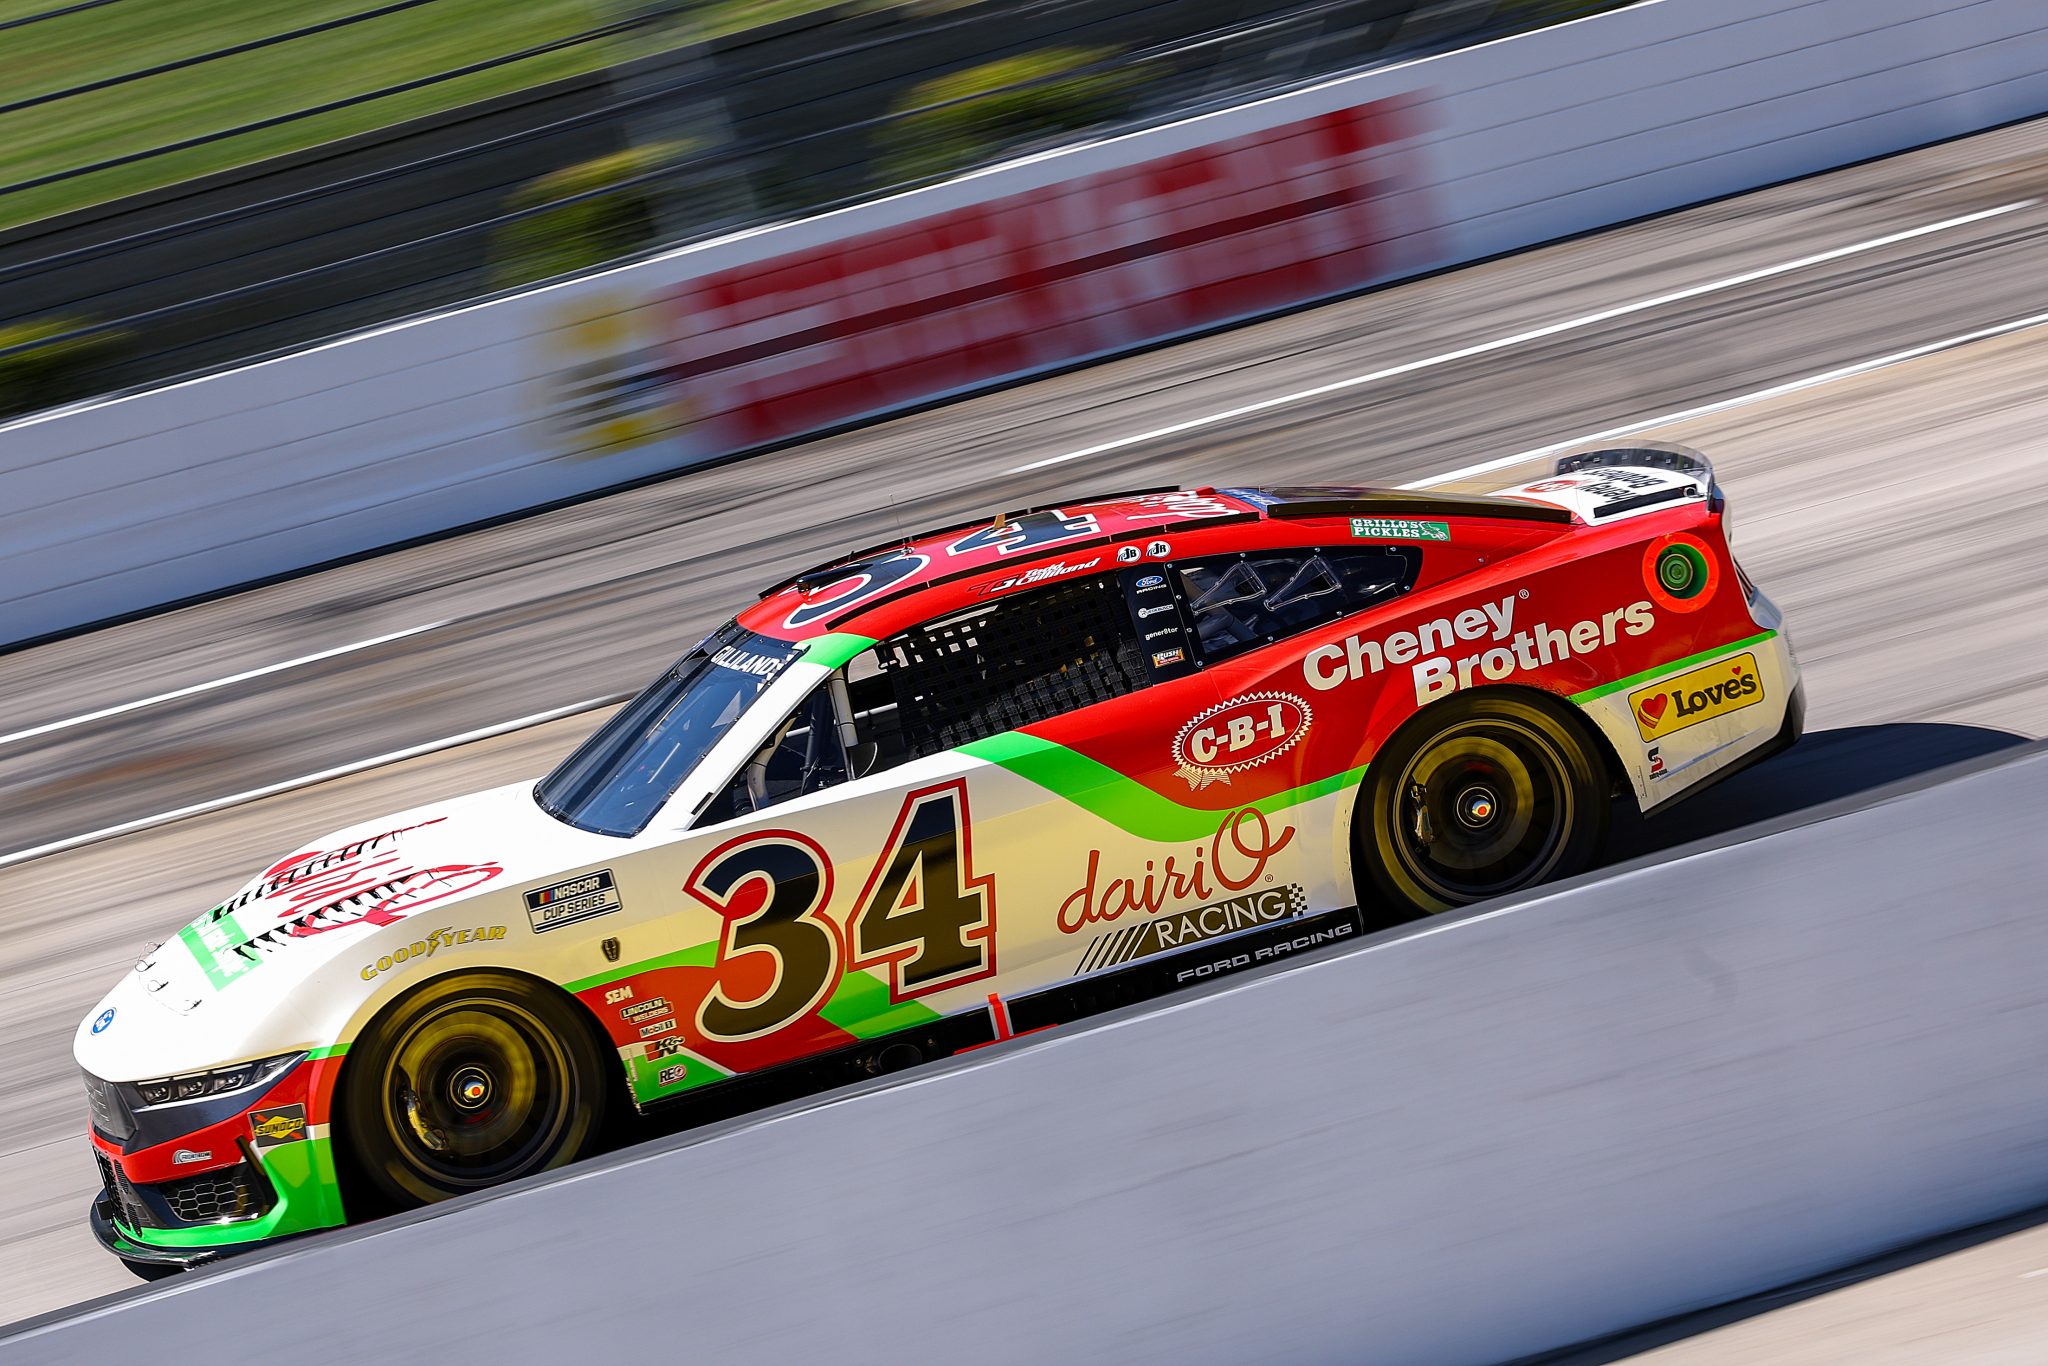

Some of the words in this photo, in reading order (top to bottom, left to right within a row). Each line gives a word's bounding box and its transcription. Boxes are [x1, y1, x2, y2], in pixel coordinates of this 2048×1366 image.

[1352, 518, 1419, 529] GRILLO'S
[1353, 527, 1420, 538] PICKLES
[1015, 557, 1101, 586] Gilliland
[1145, 627, 1179, 641] gener8tor
[1303, 595, 1516, 691] Cheney
[710, 645, 780, 676] GILLILAND
[1156, 649, 1179, 660] RUSH
[1411, 600, 1656, 707] Brothers
[1191, 703, 1286, 763] C-B-I
[553, 876, 601, 900] NASCAR
[543, 904, 566, 921] CUP
[567, 893, 606, 914] SERIES
[682, 776, 997, 1043] 34
[1154, 890, 1287, 949] RACING
[360, 926, 508, 981] GOODYEAR
[1177, 954, 1250, 983] FORD
[1255, 923, 1353, 961] RACING
[605, 985, 634, 1005] SEM
[622, 998, 665, 1018] LINCOLN
[641, 1022, 665, 1036] Mobil
[257, 1119, 302, 1135] SUNOCO
